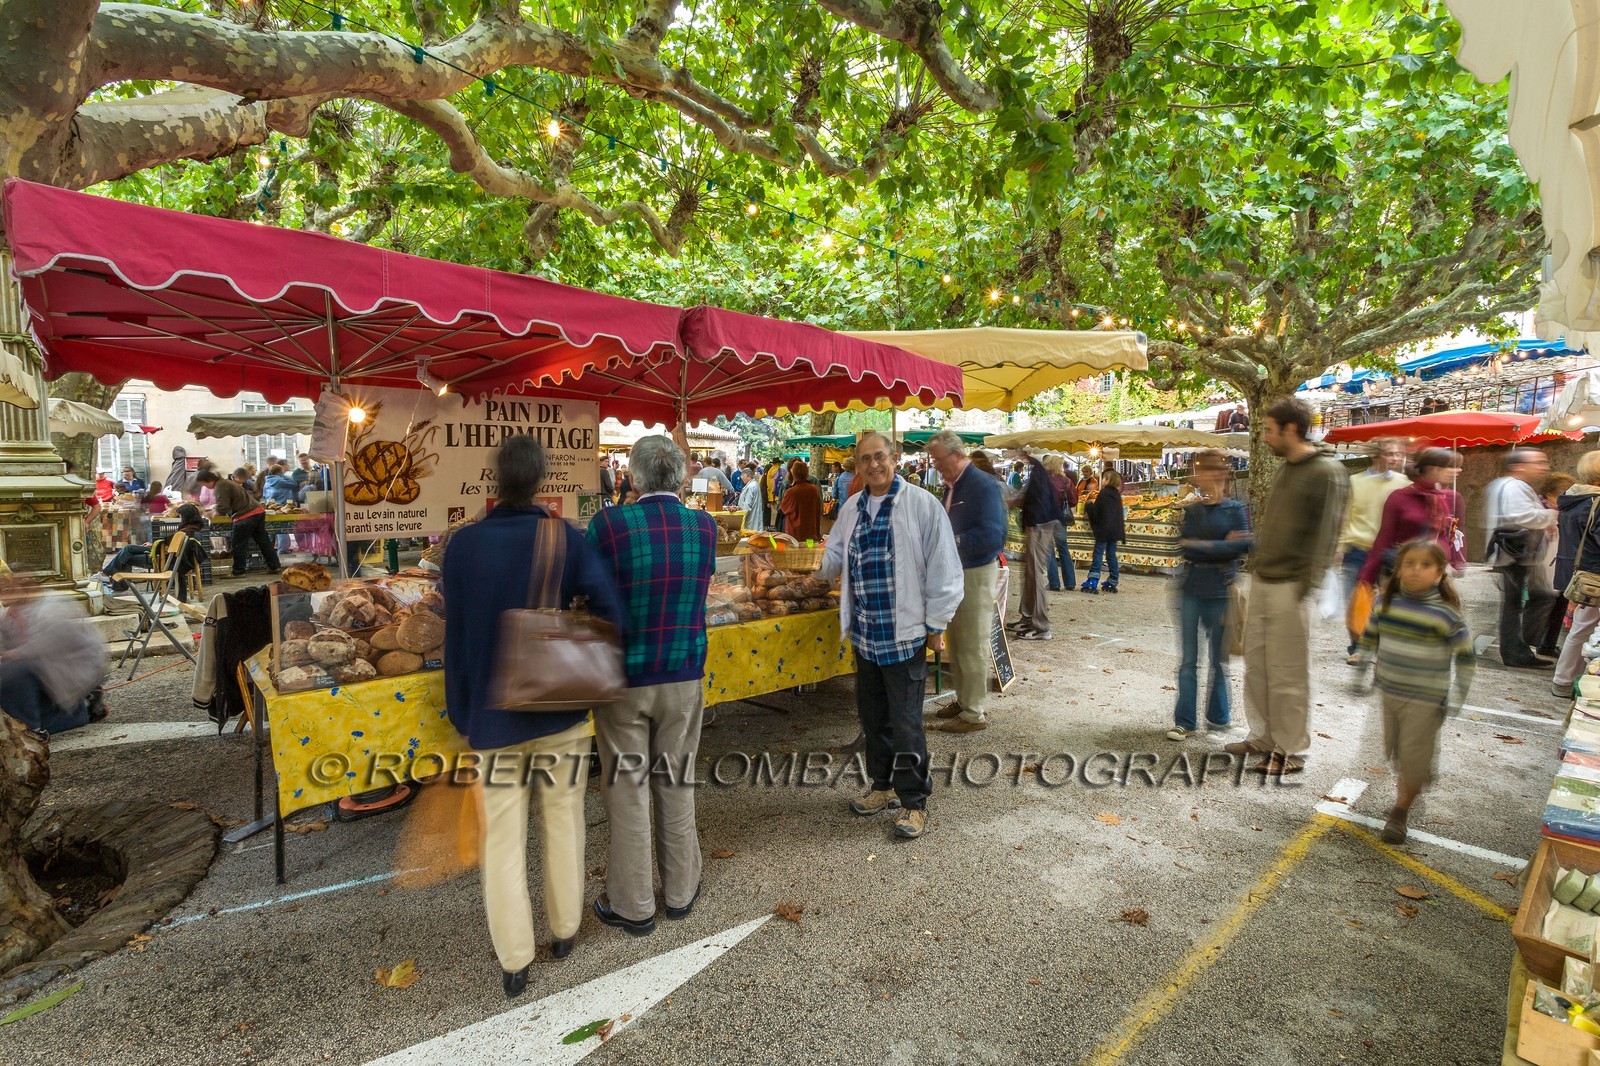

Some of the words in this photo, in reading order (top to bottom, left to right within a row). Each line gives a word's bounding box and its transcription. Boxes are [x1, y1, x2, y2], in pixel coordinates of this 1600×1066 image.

[485, 400, 531, 422] PAIN
[538, 403, 562, 424] DE
[545, 454, 576, 462] NFARON
[460, 482, 481, 495] les
[353, 512, 364, 520] au
[367, 509, 395, 519] Levain
[397, 508, 427, 519] naturel
[580, 501, 597, 516] AB
[345, 522, 372, 533] aranti
[374, 523, 394, 532] sans
[396, 522, 422, 531] levure
